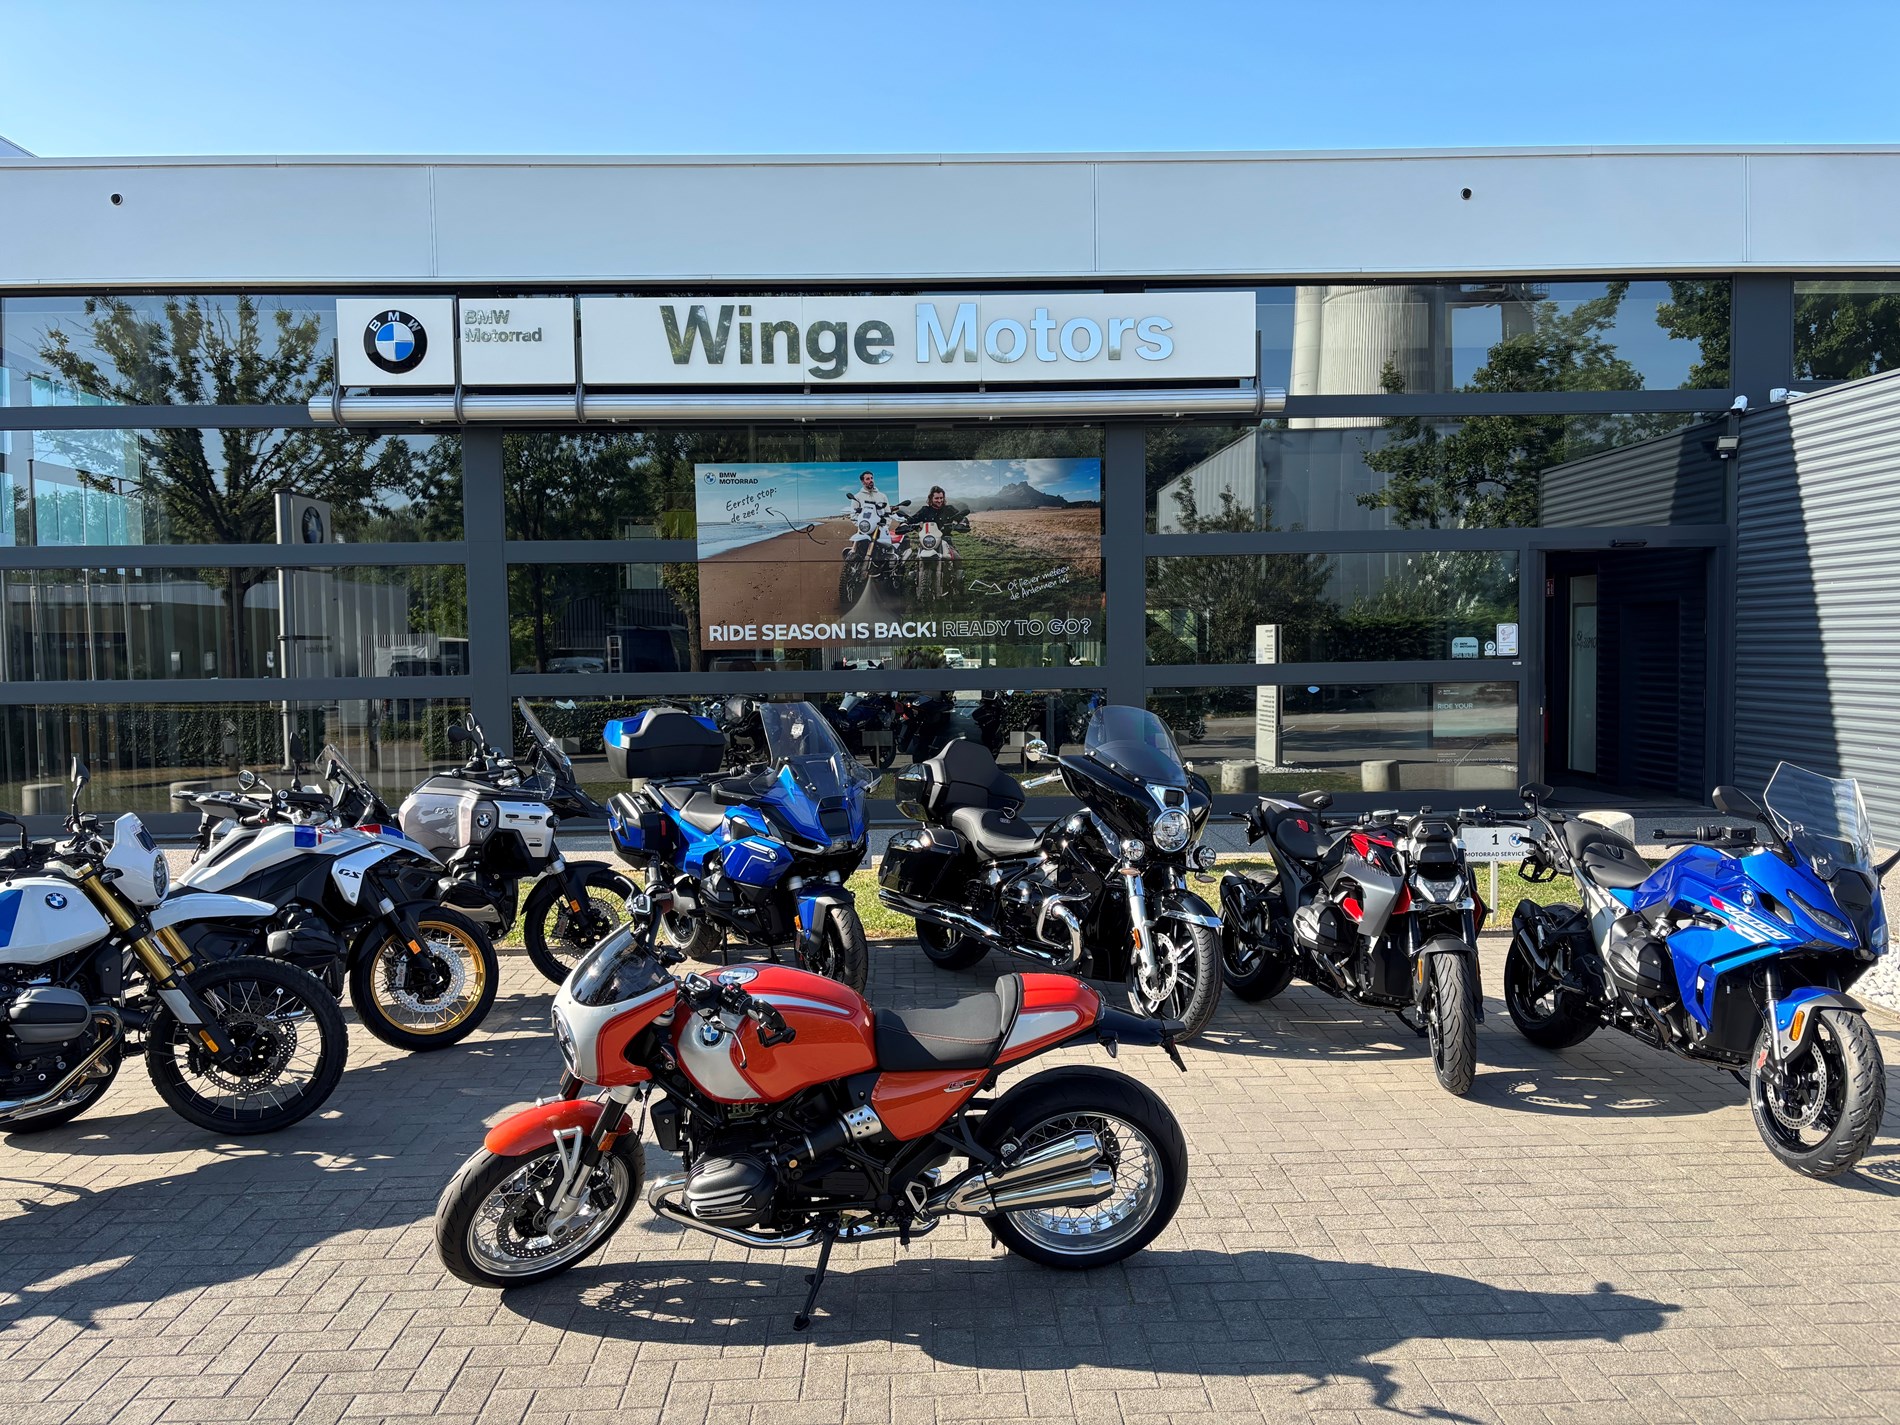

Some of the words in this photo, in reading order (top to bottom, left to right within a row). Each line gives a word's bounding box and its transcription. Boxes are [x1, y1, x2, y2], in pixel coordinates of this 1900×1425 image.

[368, 311, 422, 332] BMW
[464, 310, 510, 325] BMW
[465, 327, 543, 342] Motorrad
[659, 304, 895, 379] Winge
[915, 303, 1175, 363] Motors
[726, 494, 755, 512] Eerste
[756, 487, 778, 501] stop:
[730, 513, 741, 524] de
[742, 502, 760, 519] zee?
[709, 625, 757, 641] RIDE
[761, 623, 846, 641] SEASON
[851, 622, 870, 639] IS
[874, 621, 937, 639] BACK!
[942, 620, 1011, 637] READY
[1014, 619, 1044, 636] TO
[1047, 618, 1093, 635] GO?
[1491, 833, 1499, 846] 1
[338, 868, 362, 879] GS
